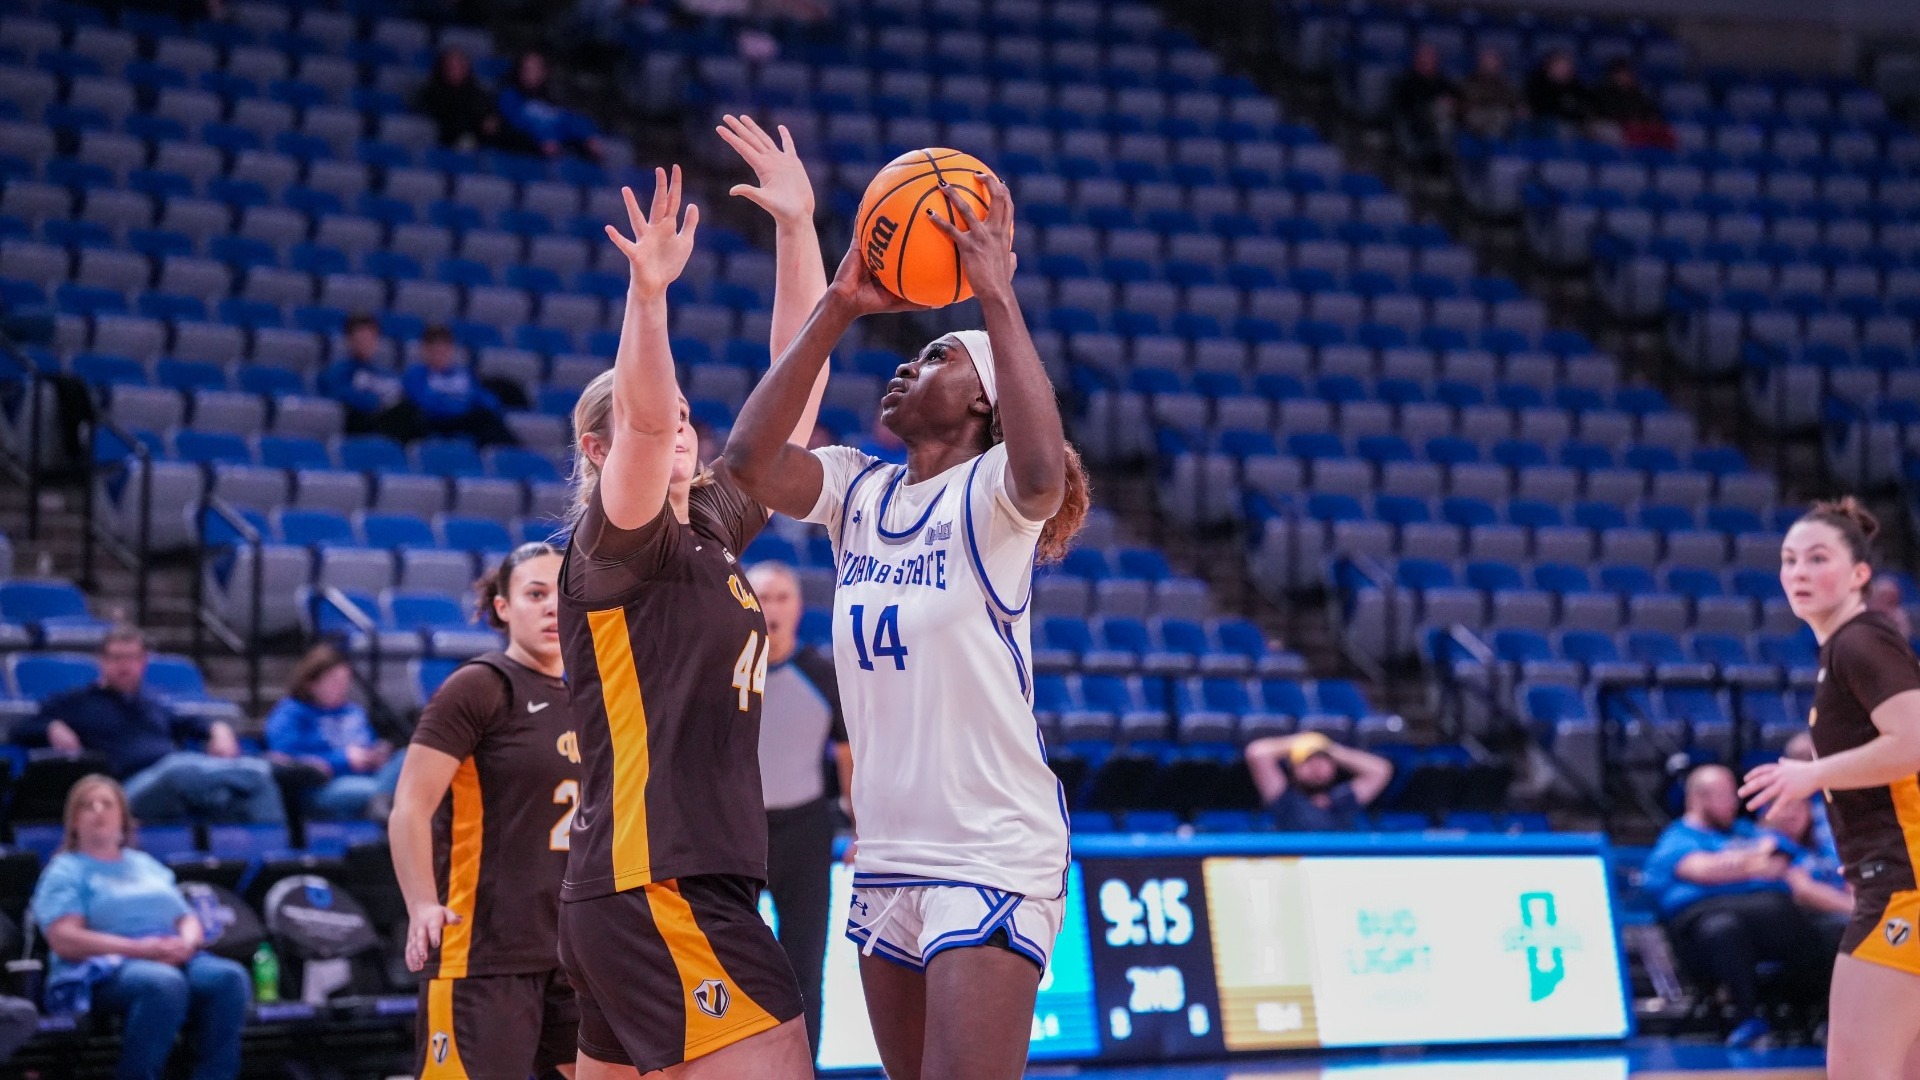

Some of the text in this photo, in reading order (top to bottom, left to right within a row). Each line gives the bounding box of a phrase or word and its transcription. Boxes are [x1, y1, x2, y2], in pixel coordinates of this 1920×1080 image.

[893, 549, 946, 590] STATE
[732, 629, 769, 711] 44
[849, 603, 909, 672] 14
[1099, 878, 1195, 946] 9:15
